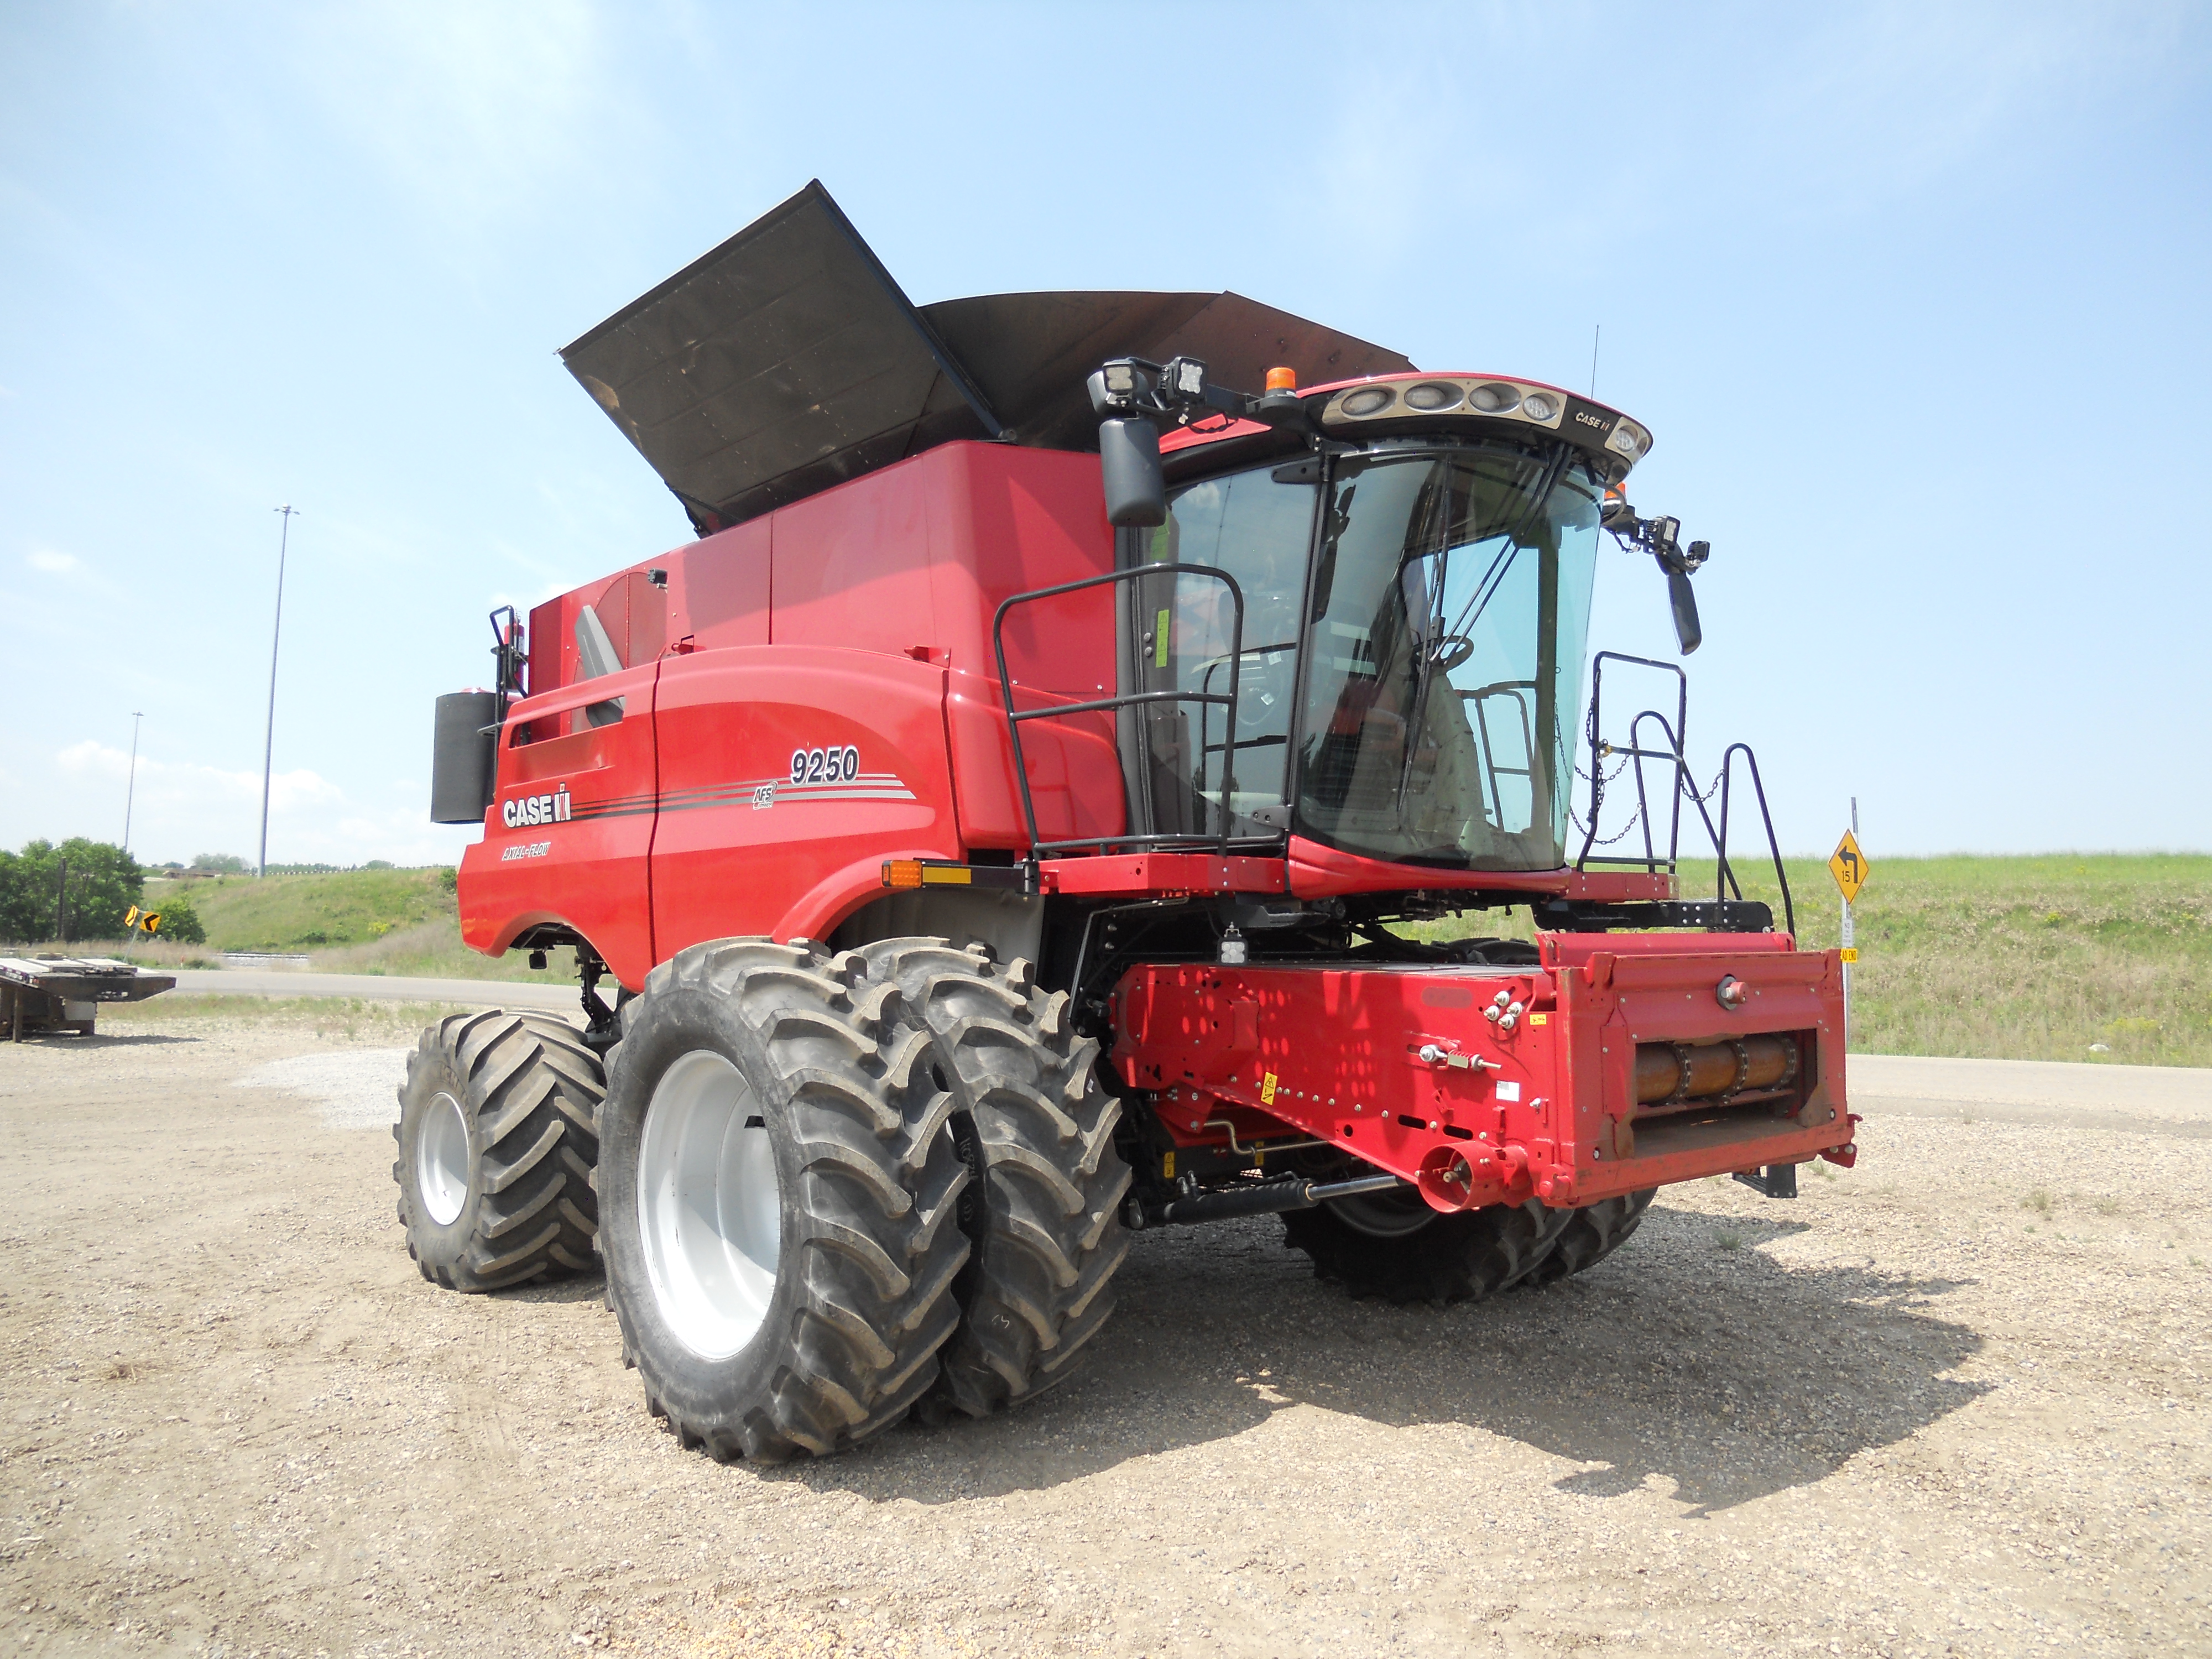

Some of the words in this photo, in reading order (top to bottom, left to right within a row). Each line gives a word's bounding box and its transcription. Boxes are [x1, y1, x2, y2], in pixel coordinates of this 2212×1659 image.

[1575, 412, 1601, 428] CASE
[790, 745, 859, 785] 9250
[753, 785, 773, 802] AFS
[504, 795, 552, 827] CASE
[502, 842, 551, 861] AXIAL-FLOW
[1842, 870, 1850, 883] 15
